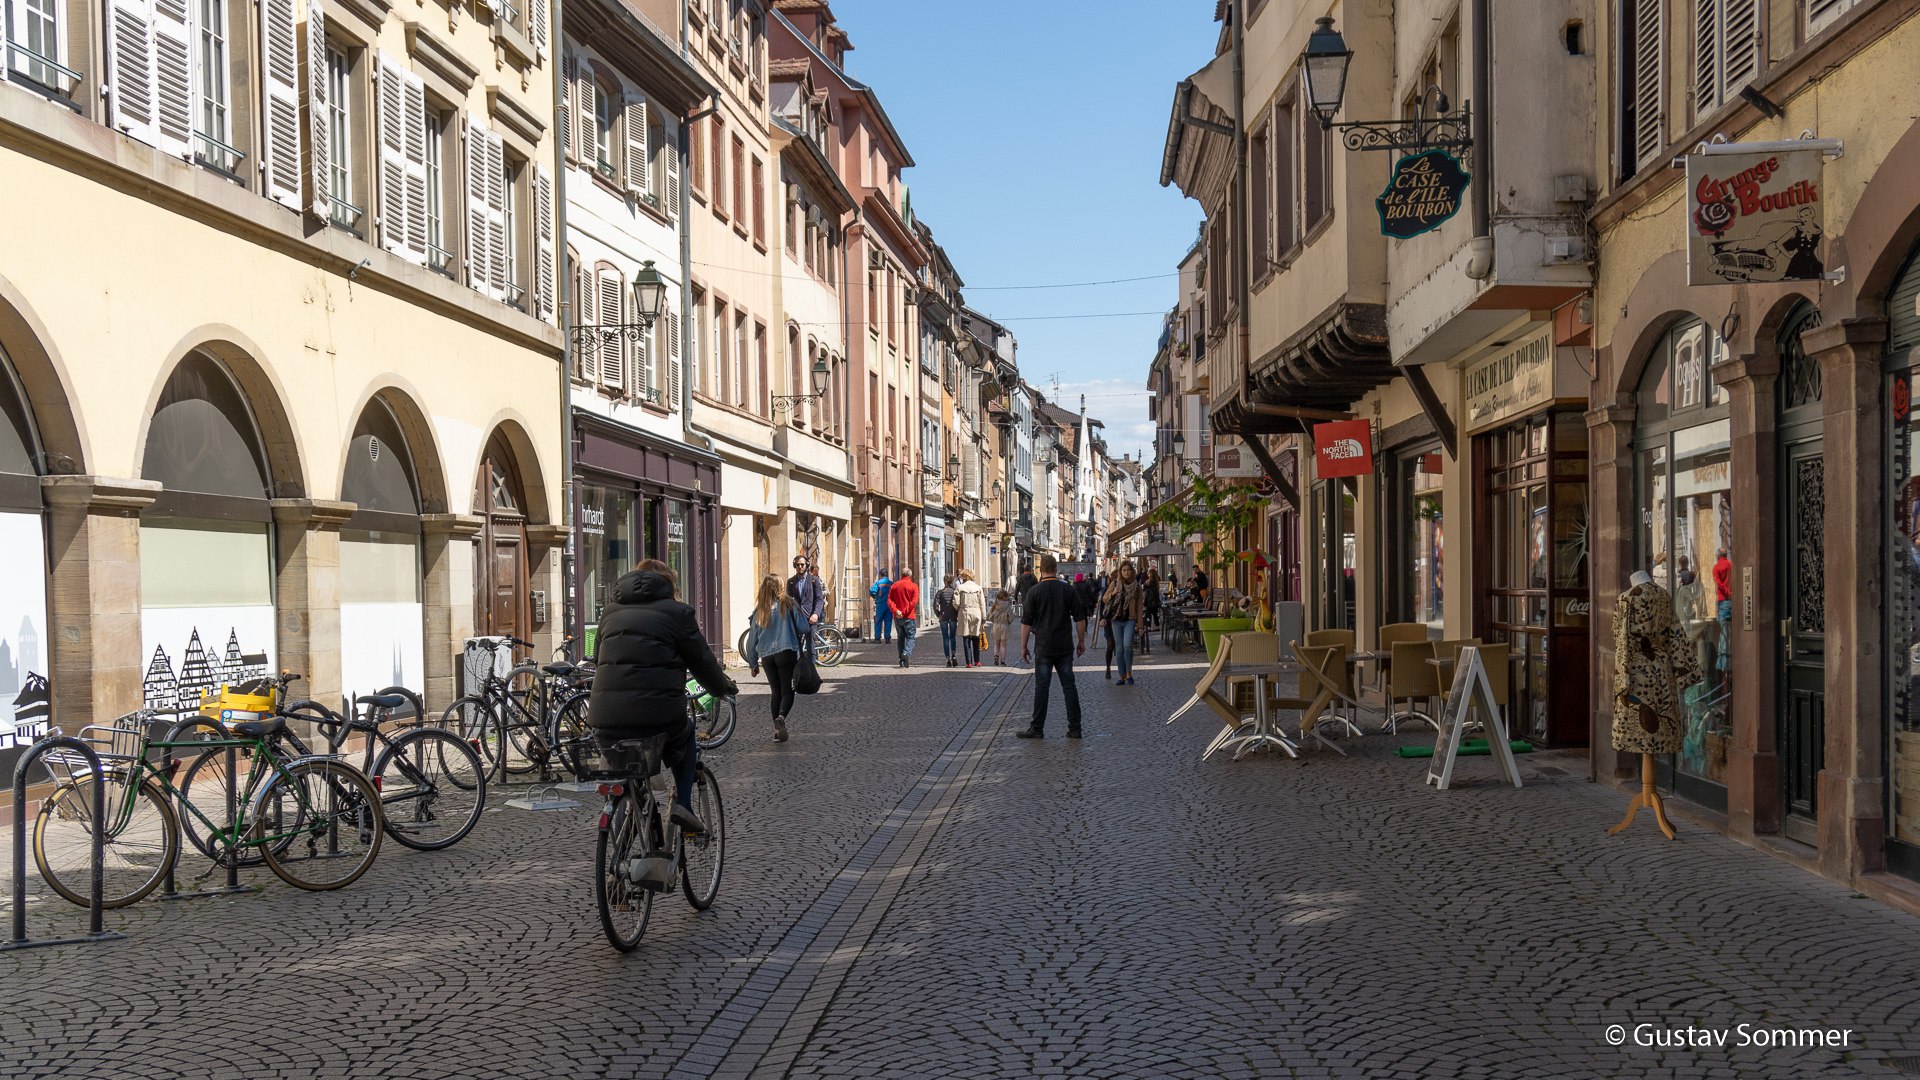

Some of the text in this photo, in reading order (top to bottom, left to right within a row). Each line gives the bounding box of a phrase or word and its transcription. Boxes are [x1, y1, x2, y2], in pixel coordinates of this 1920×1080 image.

[1400, 157, 1434, 174] La
[1395, 173, 1442, 189] CASE
[1696, 156, 1780, 204] Grunge
[1384, 191, 1403, 205] de
[1736, 179, 1819, 216] Boutik
[1386, 200, 1456, 224] BOURBON
[1466, 333, 1550, 400] LA CASE DE L'ILE BOURBON
[1323, 446, 1349, 454] NORTH
[1334, 439, 1349, 447] THE
[1331, 452, 1350, 460] FACE
[582, 503, 604, 526] hrhardt
